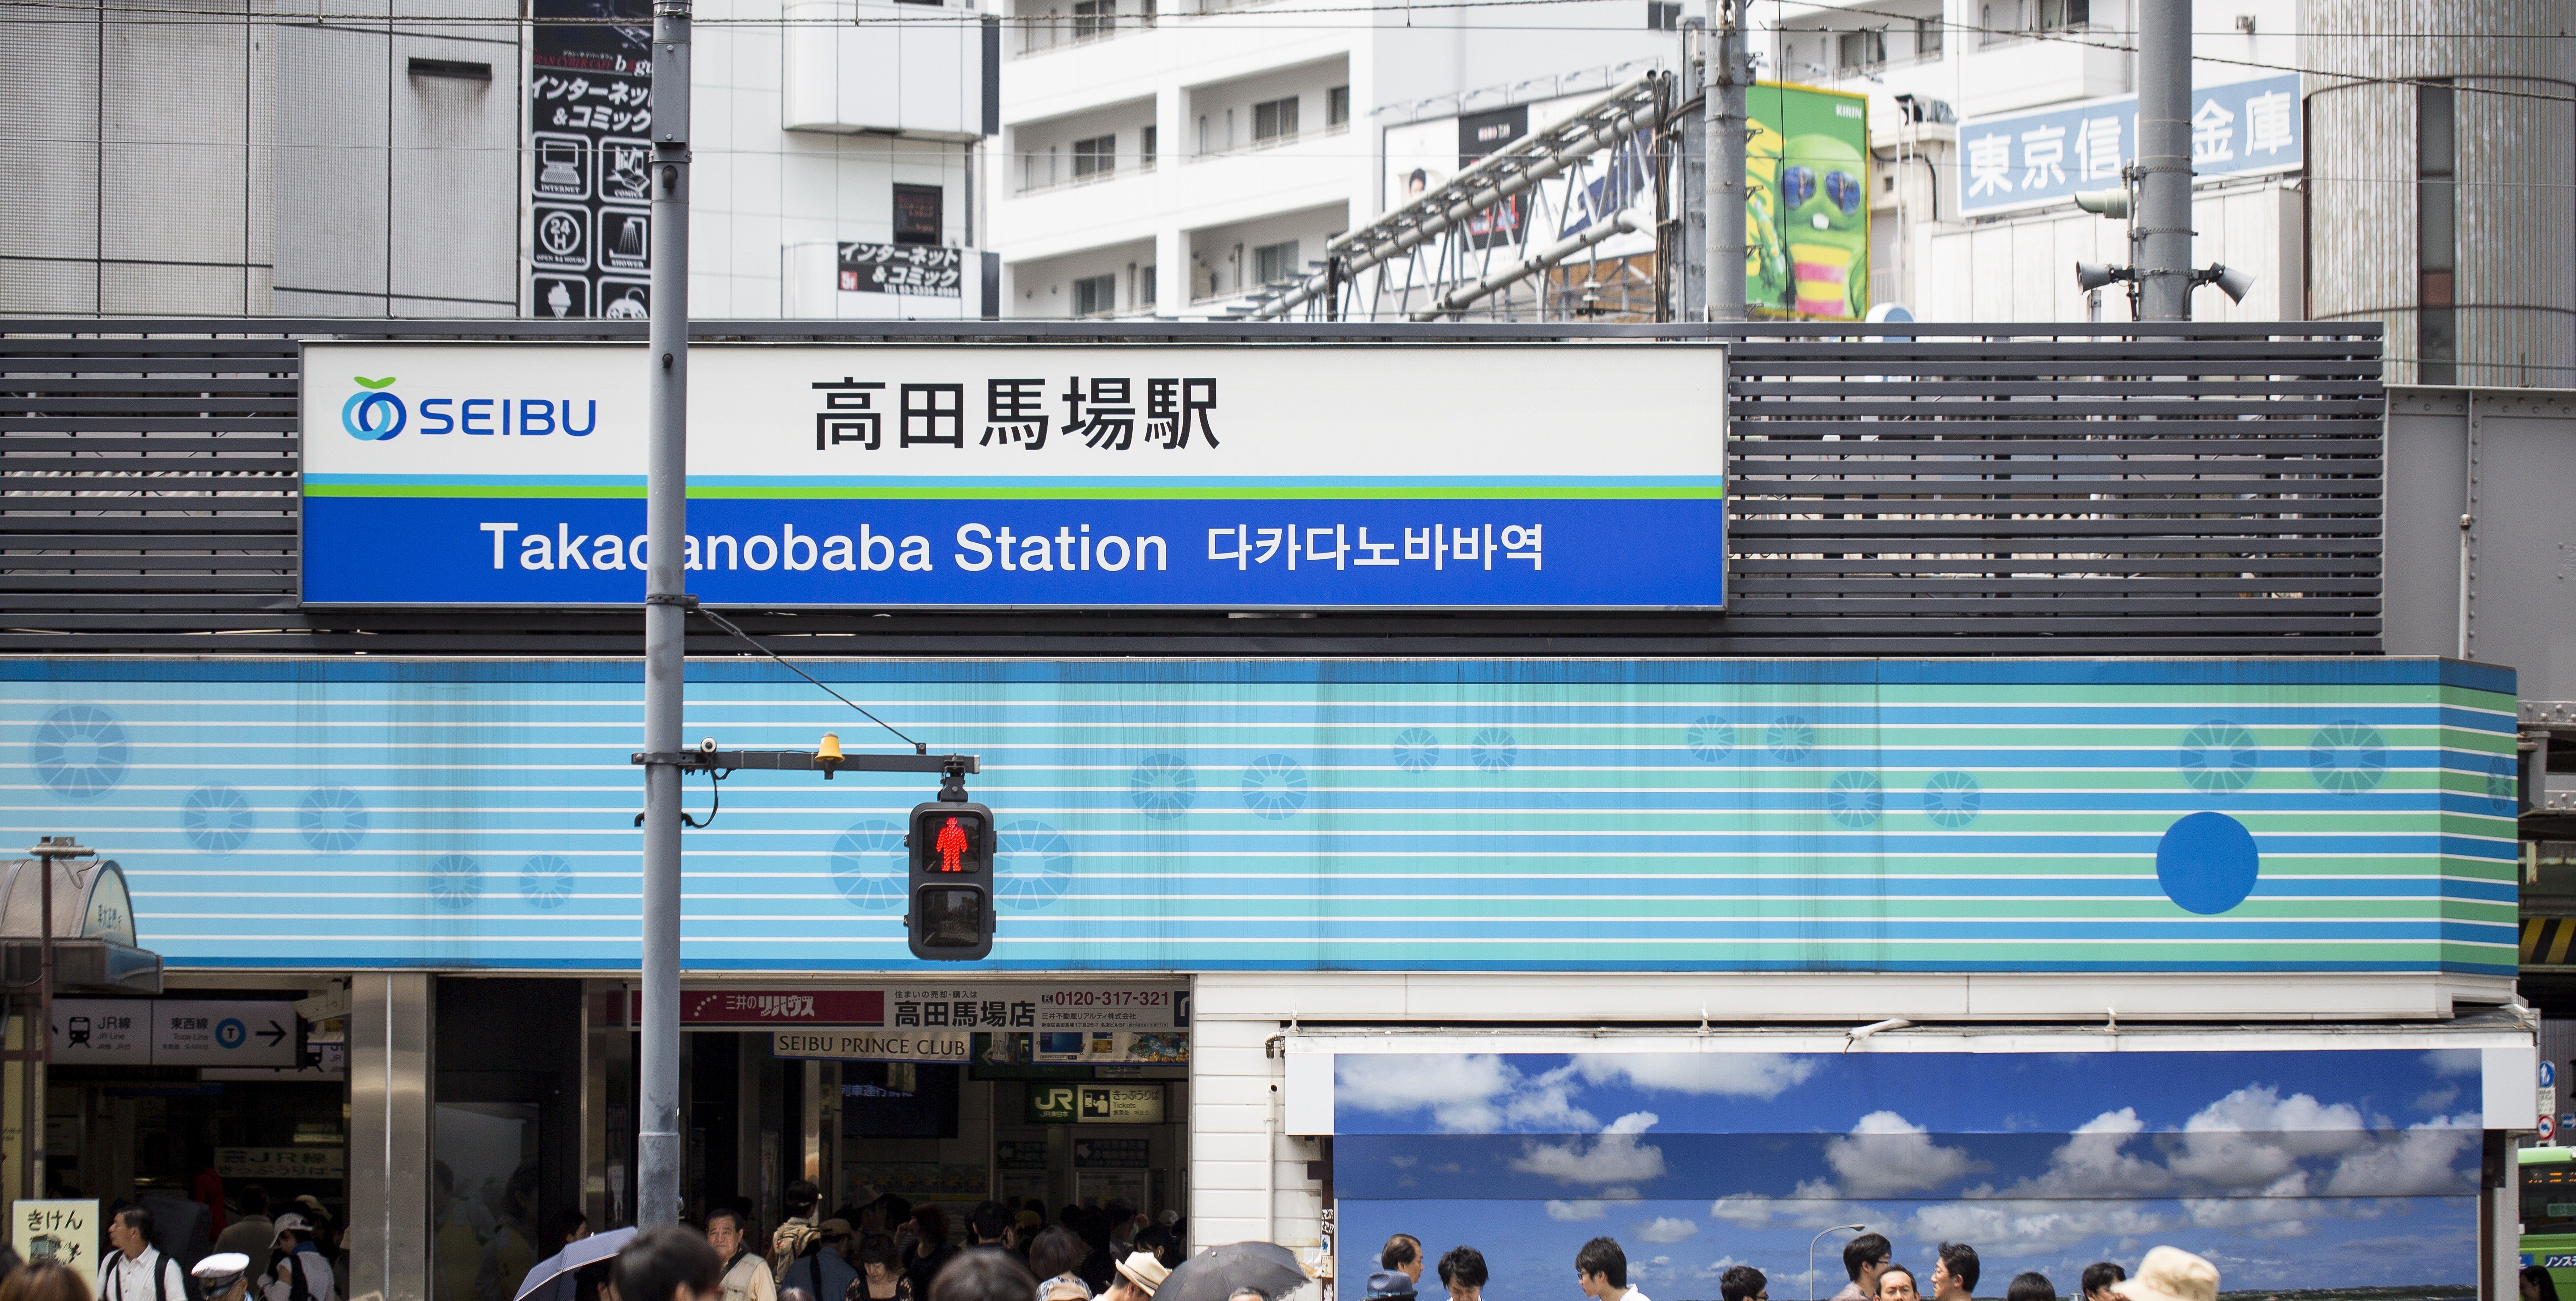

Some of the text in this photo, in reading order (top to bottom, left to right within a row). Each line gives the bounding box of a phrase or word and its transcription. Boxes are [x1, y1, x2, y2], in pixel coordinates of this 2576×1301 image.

[1836, 104, 1862, 119] KIRIN
[1968, 90, 2293, 198] 東京信金庫
[541, 184, 580, 194] INTERNET
[550, 218, 571, 236] 24
[536, 253, 553, 262] OPEN
[564, 256, 587, 265] HOURS
[611, 260, 644, 268] SHOWER
[840, 243, 958, 267] インターネット
[419, 398, 596, 437] SEIBU
[812, 376, 1220, 451] 高田馬場駅
[955, 523, 1166, 571] Station
[1208, 524, 1542, 570] 다카다노바바역
[895, 990, 977, 999] 住まいの売却・購入は
[1055, 991, 1168, 1005] 0120-317-321
[97, 1016, 131, 1029] JR線
[894, 1000, 1036, 1027] 高田馬場店
[171, 1017, 208, 1030] 東西線
[227, 1028, 234, 1039] T
[779, 1035, 966, 1056] SEIBU PRINCE CLUB
[1035, 1089, 1073, 1110] JR
[1112, 1090, 1160, 1101] きっぷうりば
[28, 1209, 83, 1231] きけん
